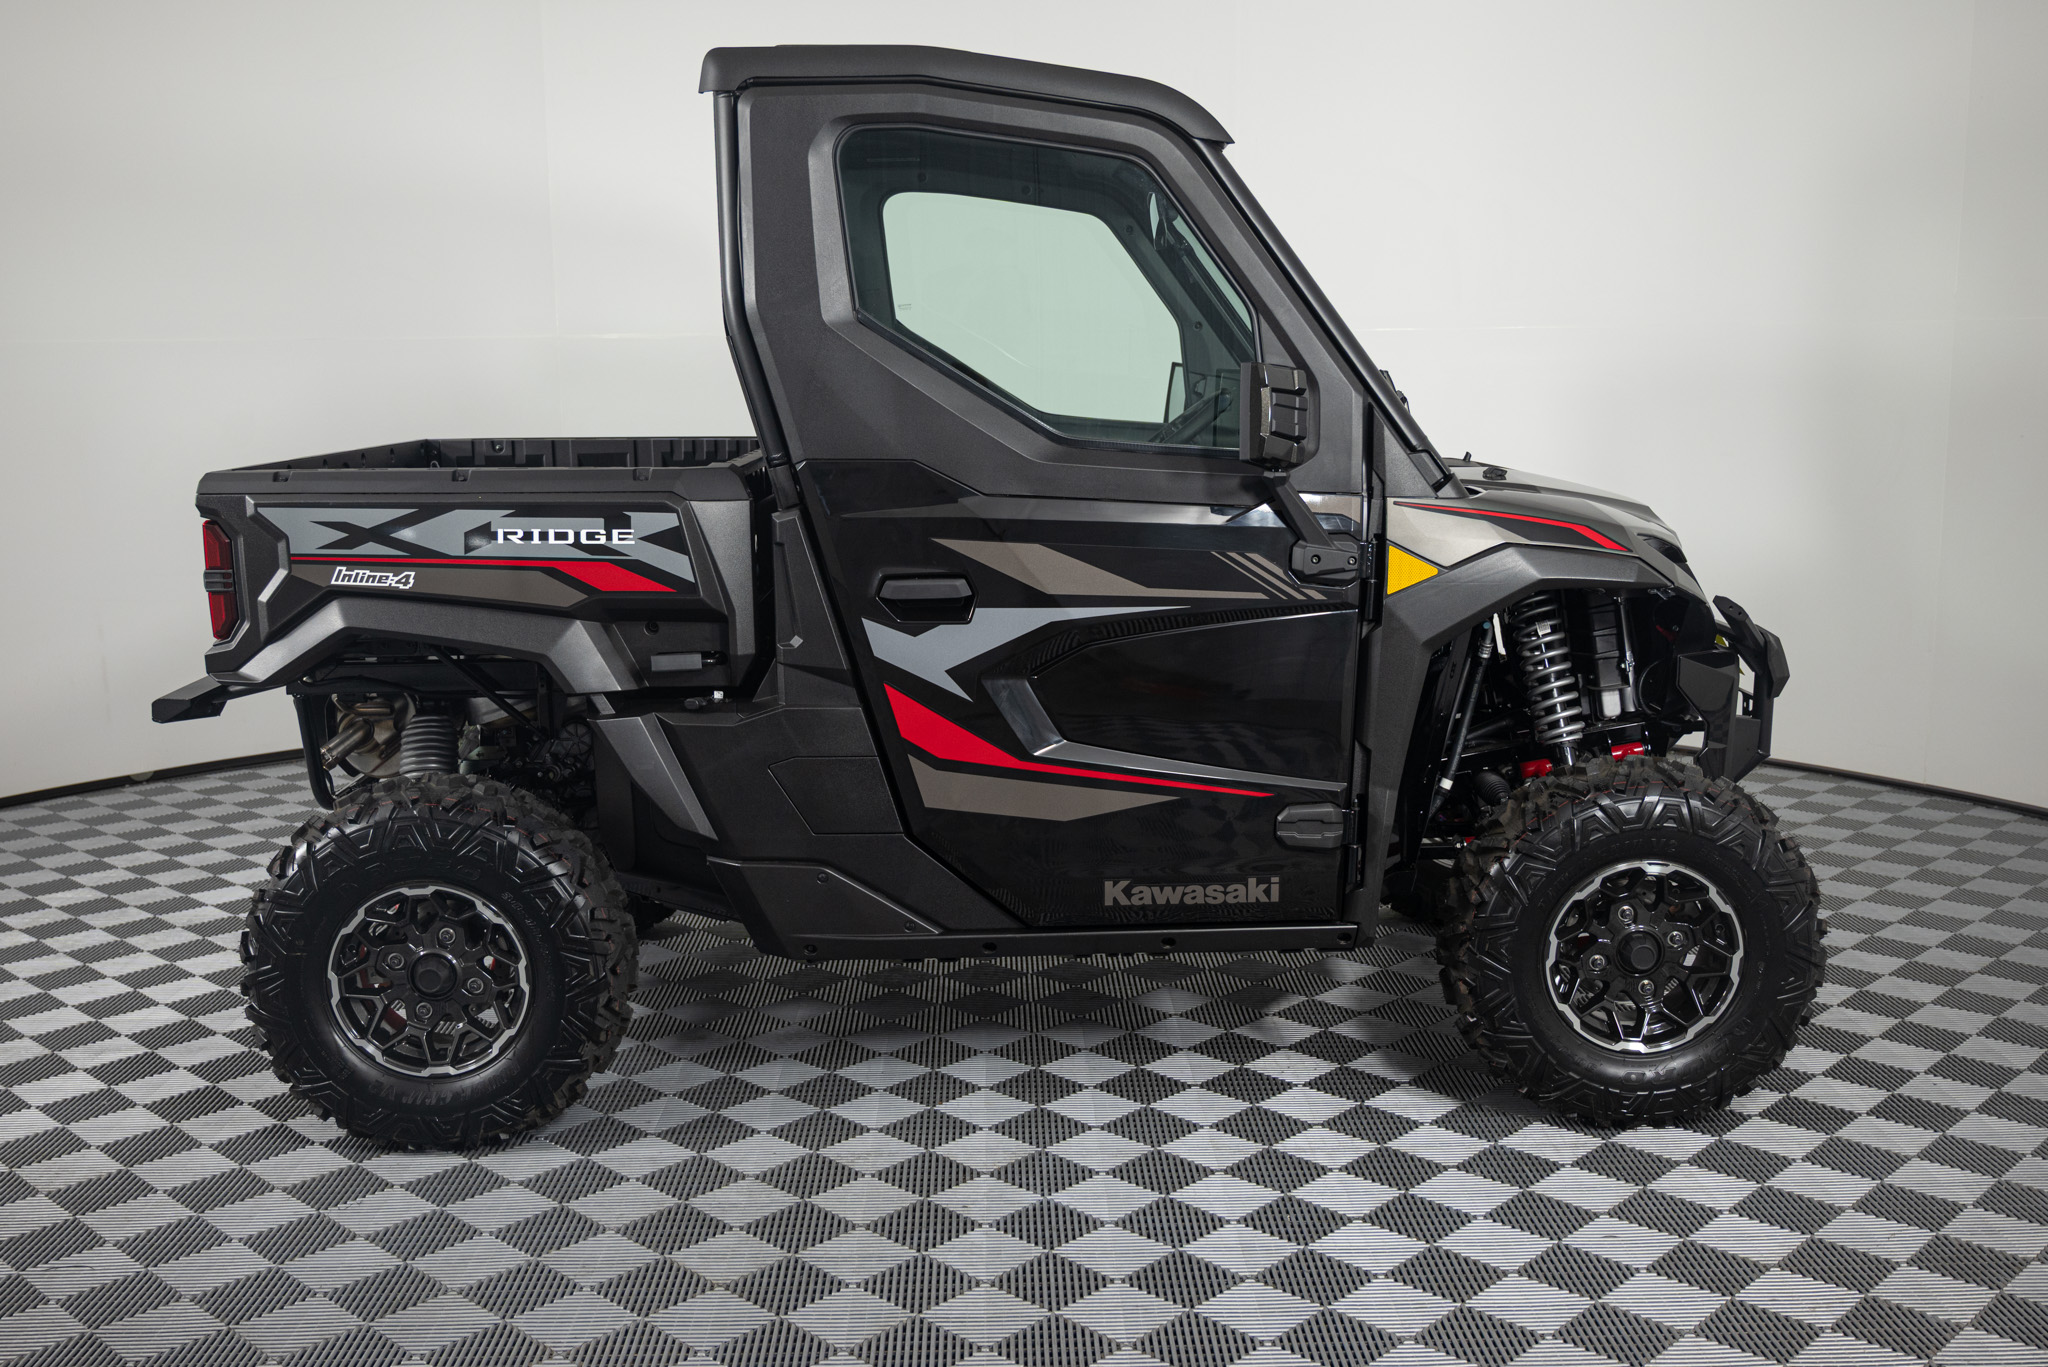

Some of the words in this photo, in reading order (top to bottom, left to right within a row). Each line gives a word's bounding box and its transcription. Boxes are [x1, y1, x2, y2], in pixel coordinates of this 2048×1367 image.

[498, 528, 635, 545] RIDGE
[331, 566, 415, 589] Inline-4
[1104, 877, 1280, 906] Kawasaki
